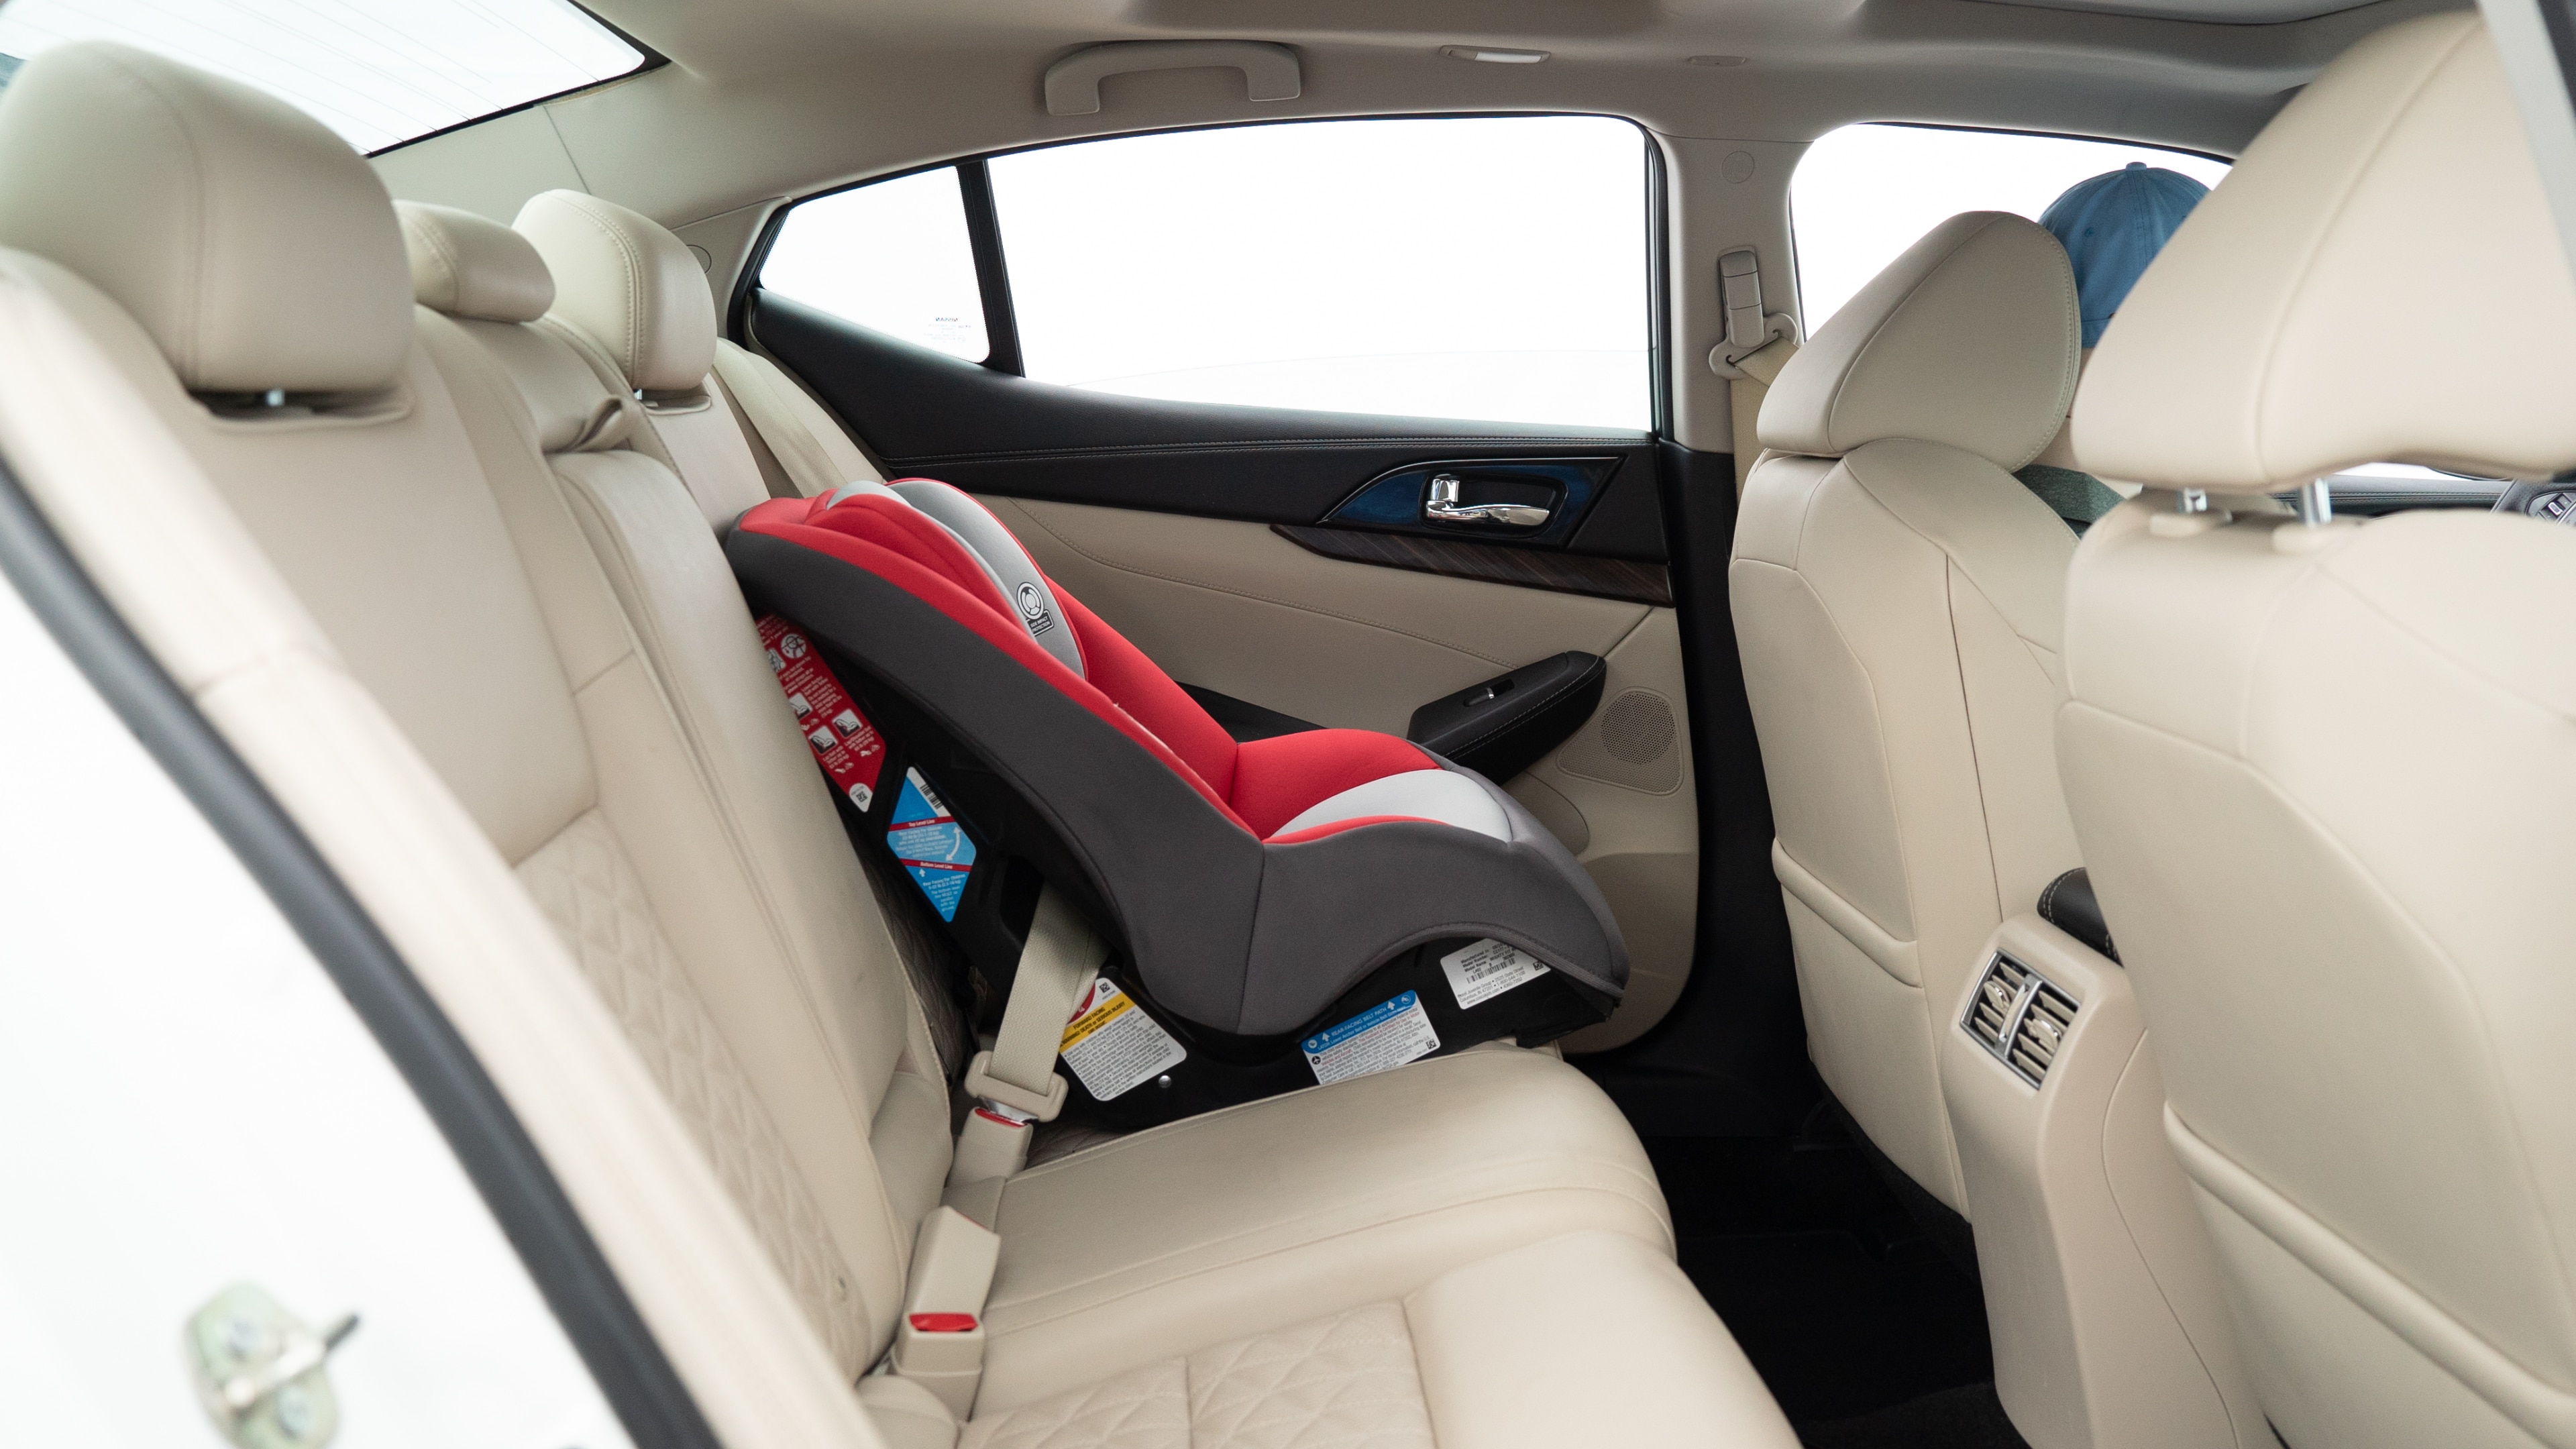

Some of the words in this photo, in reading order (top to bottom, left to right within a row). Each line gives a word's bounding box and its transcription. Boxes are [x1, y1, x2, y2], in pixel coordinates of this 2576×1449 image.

[1032, 621, 1051, 633] PROTECTION
[1036, 616, 1049, 625] IMPACT
[1073, 1015, 1093, 1030] FORWARD
[1091, 1006, 1106, 1018] FACING
[1079, 1022, 1093, 1033] DEATH
[1095, 1010, 1113, 1022] SERIOUS
[1111, 1001, 1126, 1012] INJURY
[1331, 1018, 1363, 1036] REAR-FACING
[1362, 1013, 1374, 1022] BELT
[1374, 1006, 1387, 1016] PATH
